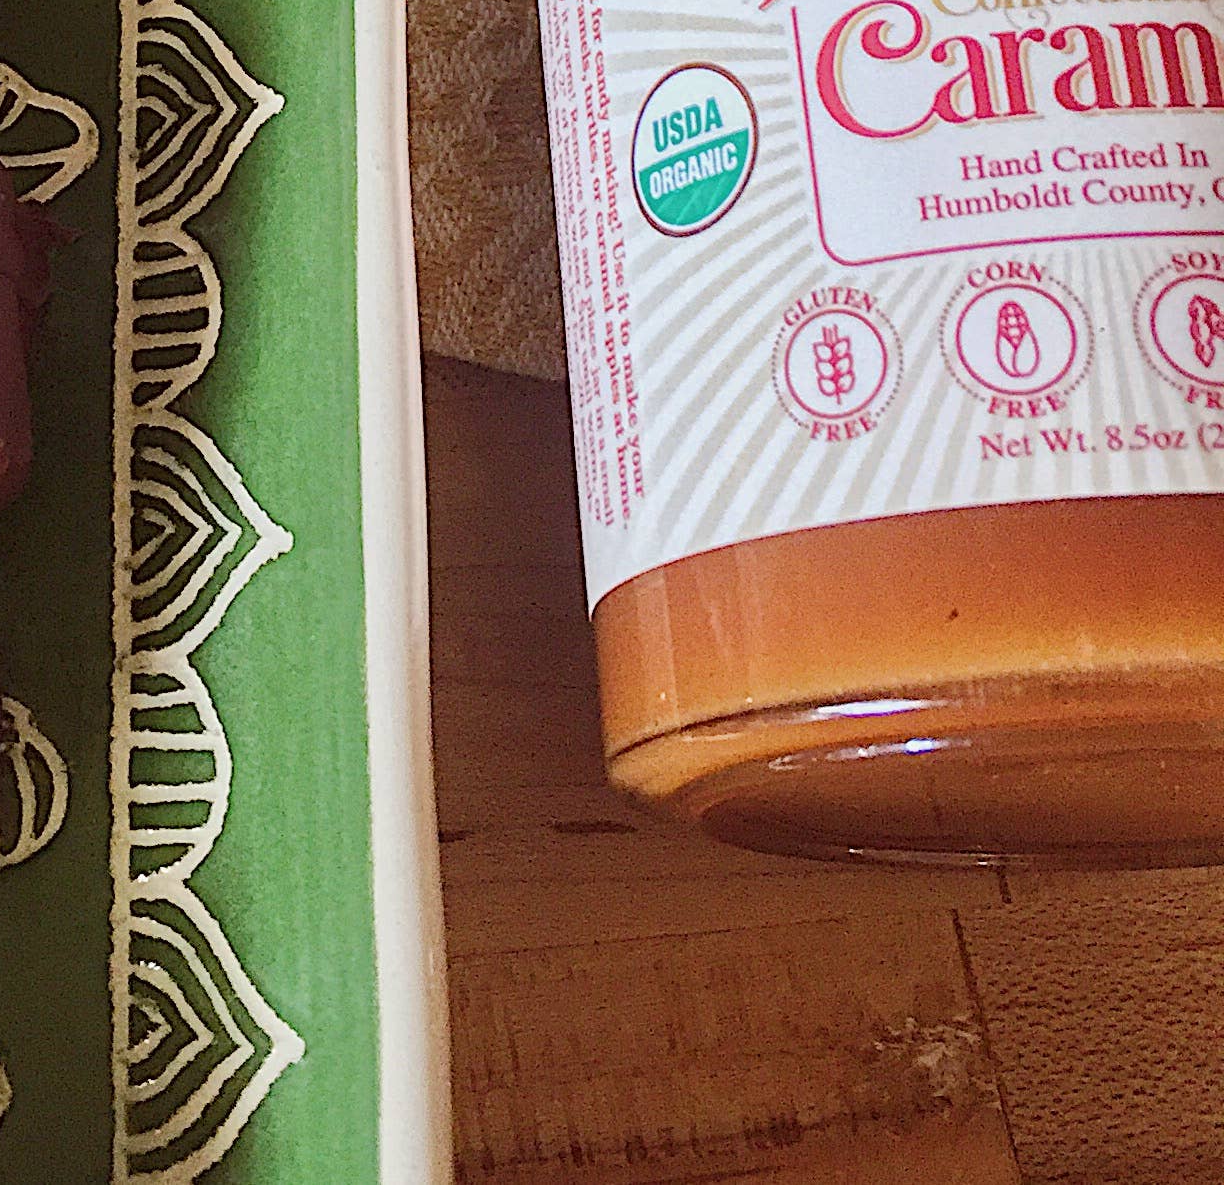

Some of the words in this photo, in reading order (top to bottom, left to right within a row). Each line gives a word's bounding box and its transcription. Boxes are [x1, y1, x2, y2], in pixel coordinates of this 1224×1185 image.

[591, 7, 603, 43] for
[595, 50, 610, 121] candy
[584, 83, 598, 174] turtles,
[652, 96, 724, 153] USDA
[602, 128, 623, 233] making!
[649, 141, 738, 200] ORGANIC
[959, 149, 1043, 181] Hand
[1052, 142, 1168, 173] Crafted
[1177, 142, 1209, 168] In
[593, 177, 602, 203] or
[917, 181, 1073, 222] Humboldt
[1081, 179, 1206, 209] County,
[596, 211, 614, 314] caramel
[613, 236, 626, 289] Use
[966, 260, 1048, 289] CORN
[616, 292, 630, 314] it
[783, 286, 878, 328] GLUTEN
[620, 318, 631, 347] to
[604, 320, 620, 405] apples
[622, 353, 638, 428] make
[987, 390, 1068, 419] FREE
[613, 412, 624, 438] at
[808, 412, 878, 443] FREE
[978, 432, 1033, 460] Net
[1040, 427, 1098, 454] Wt.
[616, 445, 631, 530] home.
[627, 434, 644, 498] your
